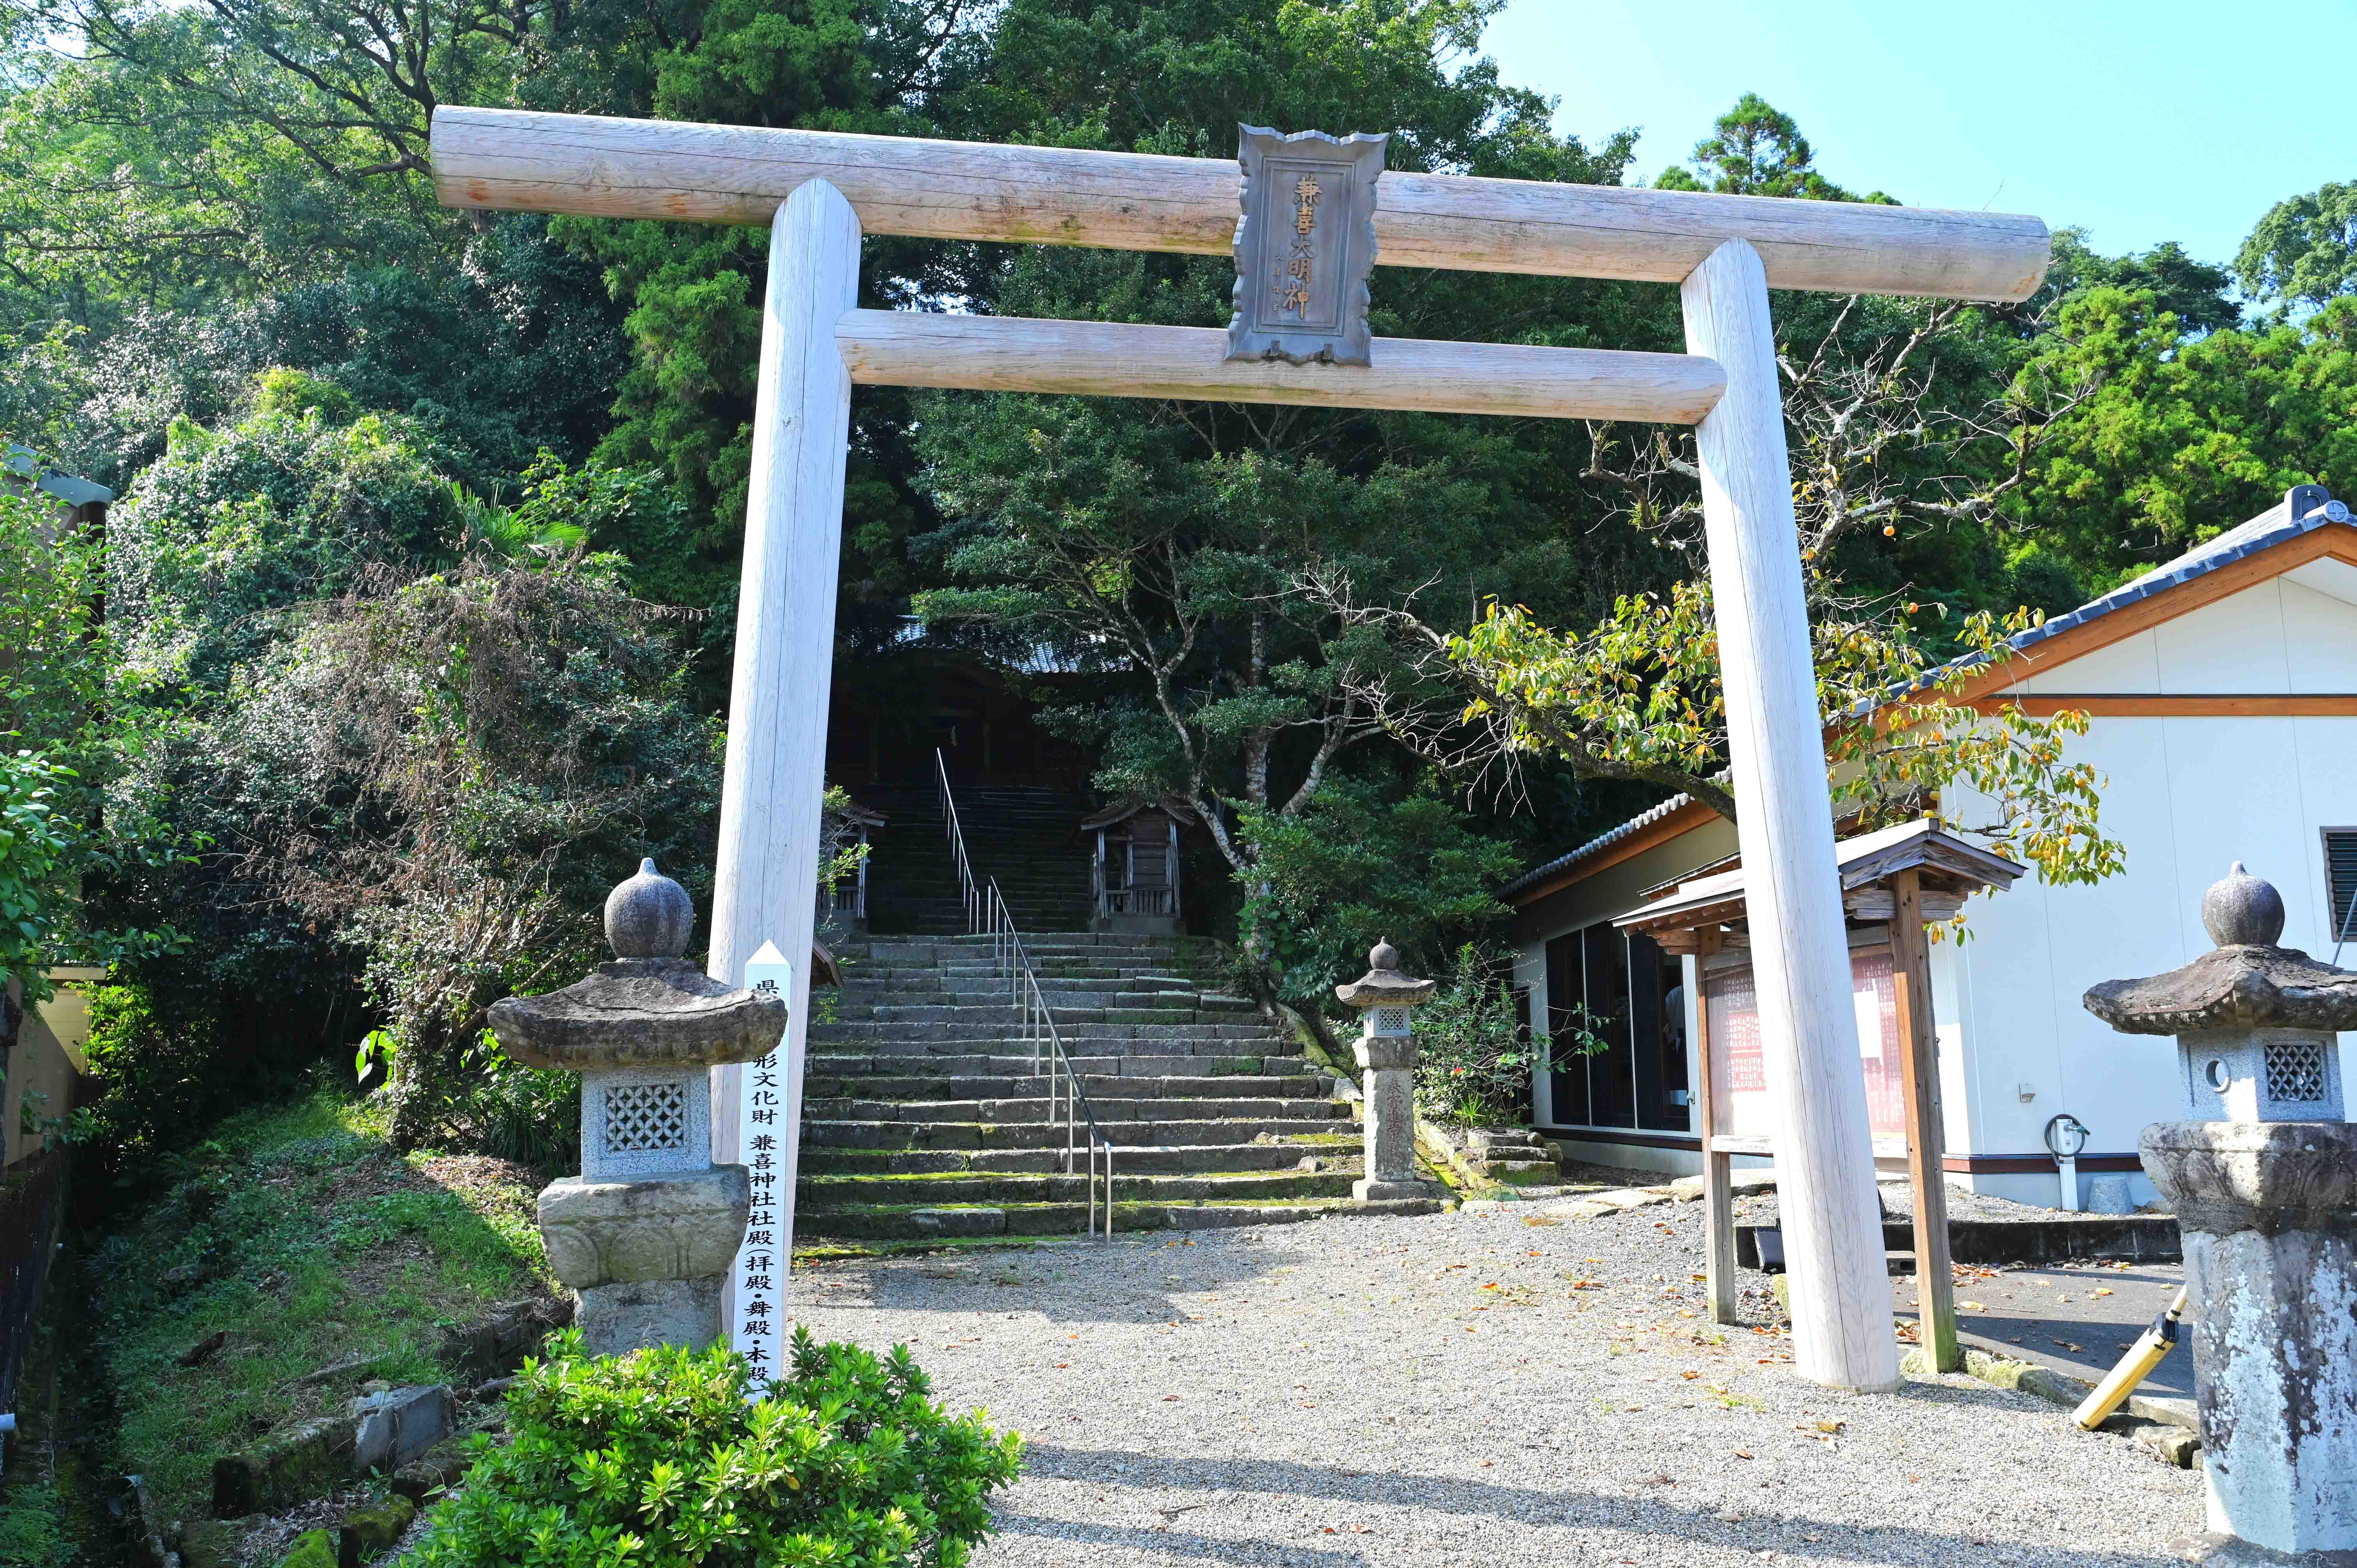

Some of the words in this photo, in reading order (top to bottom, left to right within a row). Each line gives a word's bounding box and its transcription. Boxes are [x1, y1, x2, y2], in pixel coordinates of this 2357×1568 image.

[1282, 174, 1323, 319] 兼喜大明神
[749, 979, 780, 1125] 県形文化財
